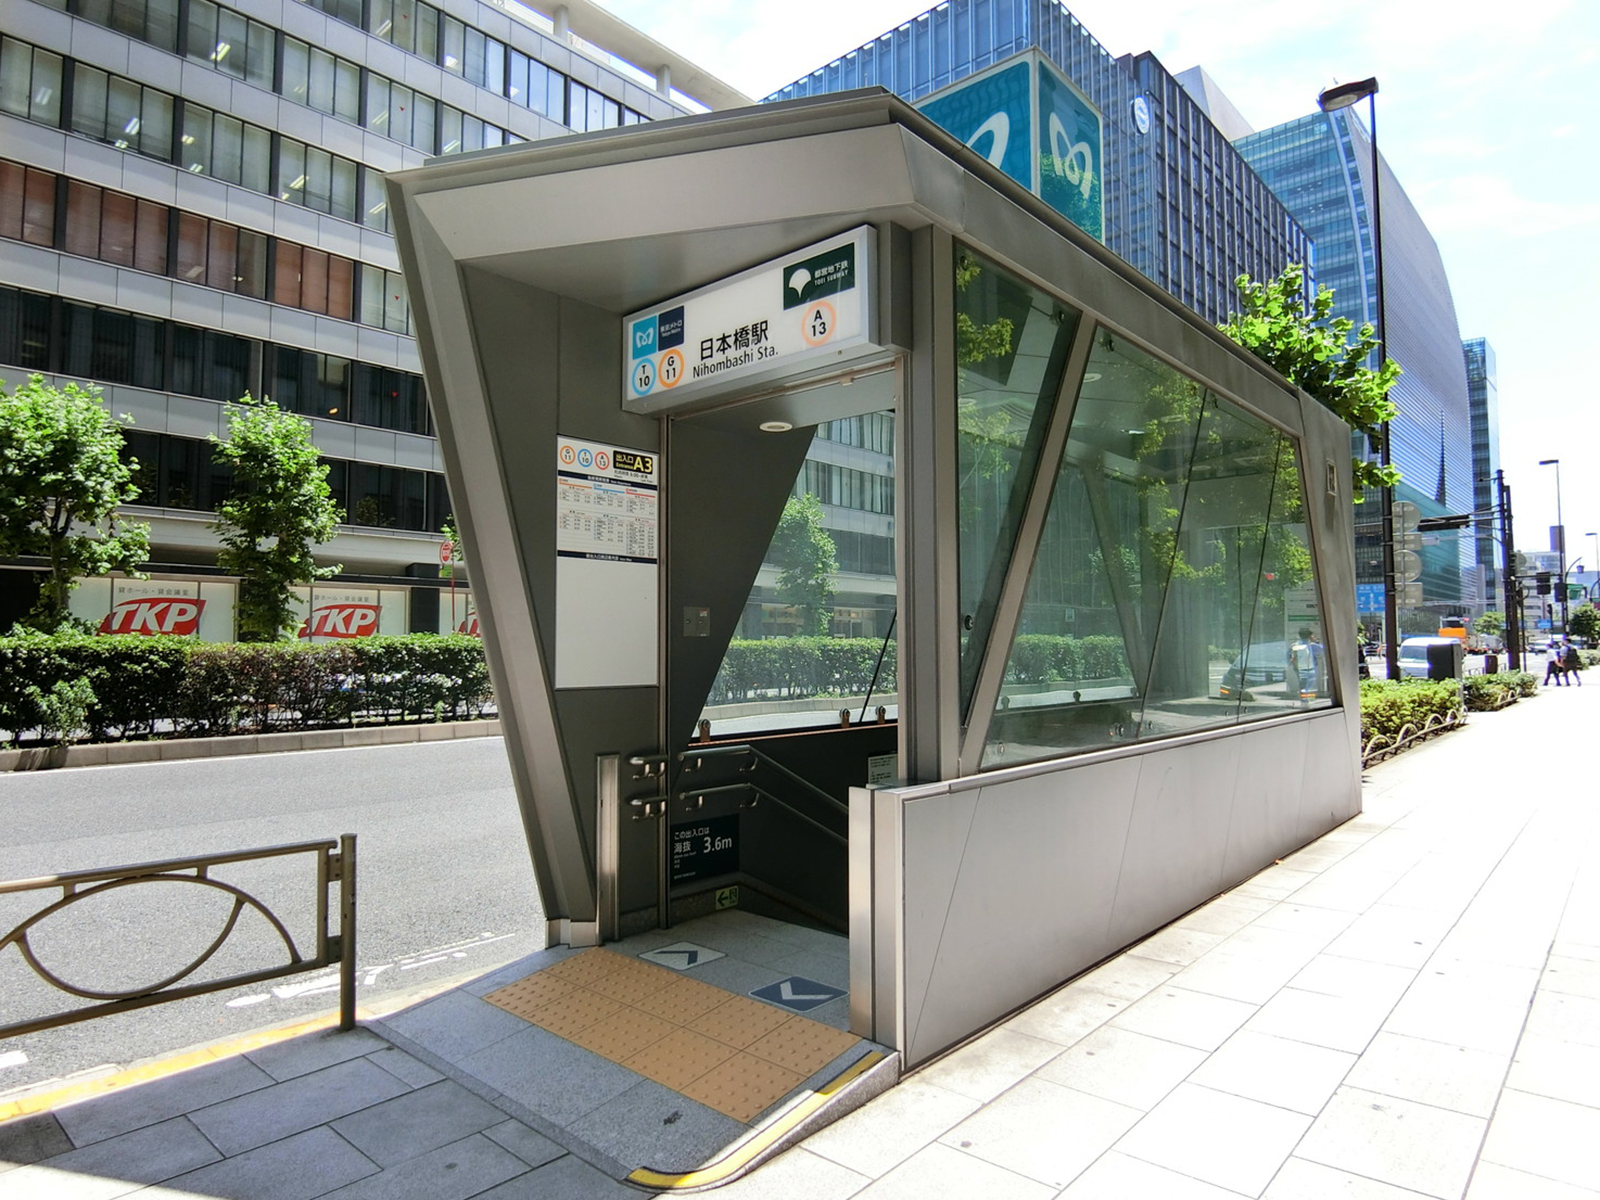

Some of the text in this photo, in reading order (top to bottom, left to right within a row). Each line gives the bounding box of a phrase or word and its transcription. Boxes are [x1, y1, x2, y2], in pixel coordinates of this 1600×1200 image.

[813, 309, 823, 322] A
[812, 322, 827, 337] 13
[700, 319, 769, 362] 日本橋駅
[667, 355, 675, 367] G
[692, 345, 779, 379] Nihombashi Sta.
[641, 364, 647, 375] T
[665, 367, 676, 380] 11
[639, 375, 650, 388] 10
[615, 453, 634, 464] 出入口
[633, 456, 653, 473] A3
[111, 602, 198, 632] TKP
[306, 608, 377, 634] TKP
[674, 827, 709, 840] この出入口は
[703, 836, 732, 853] 3.6m
